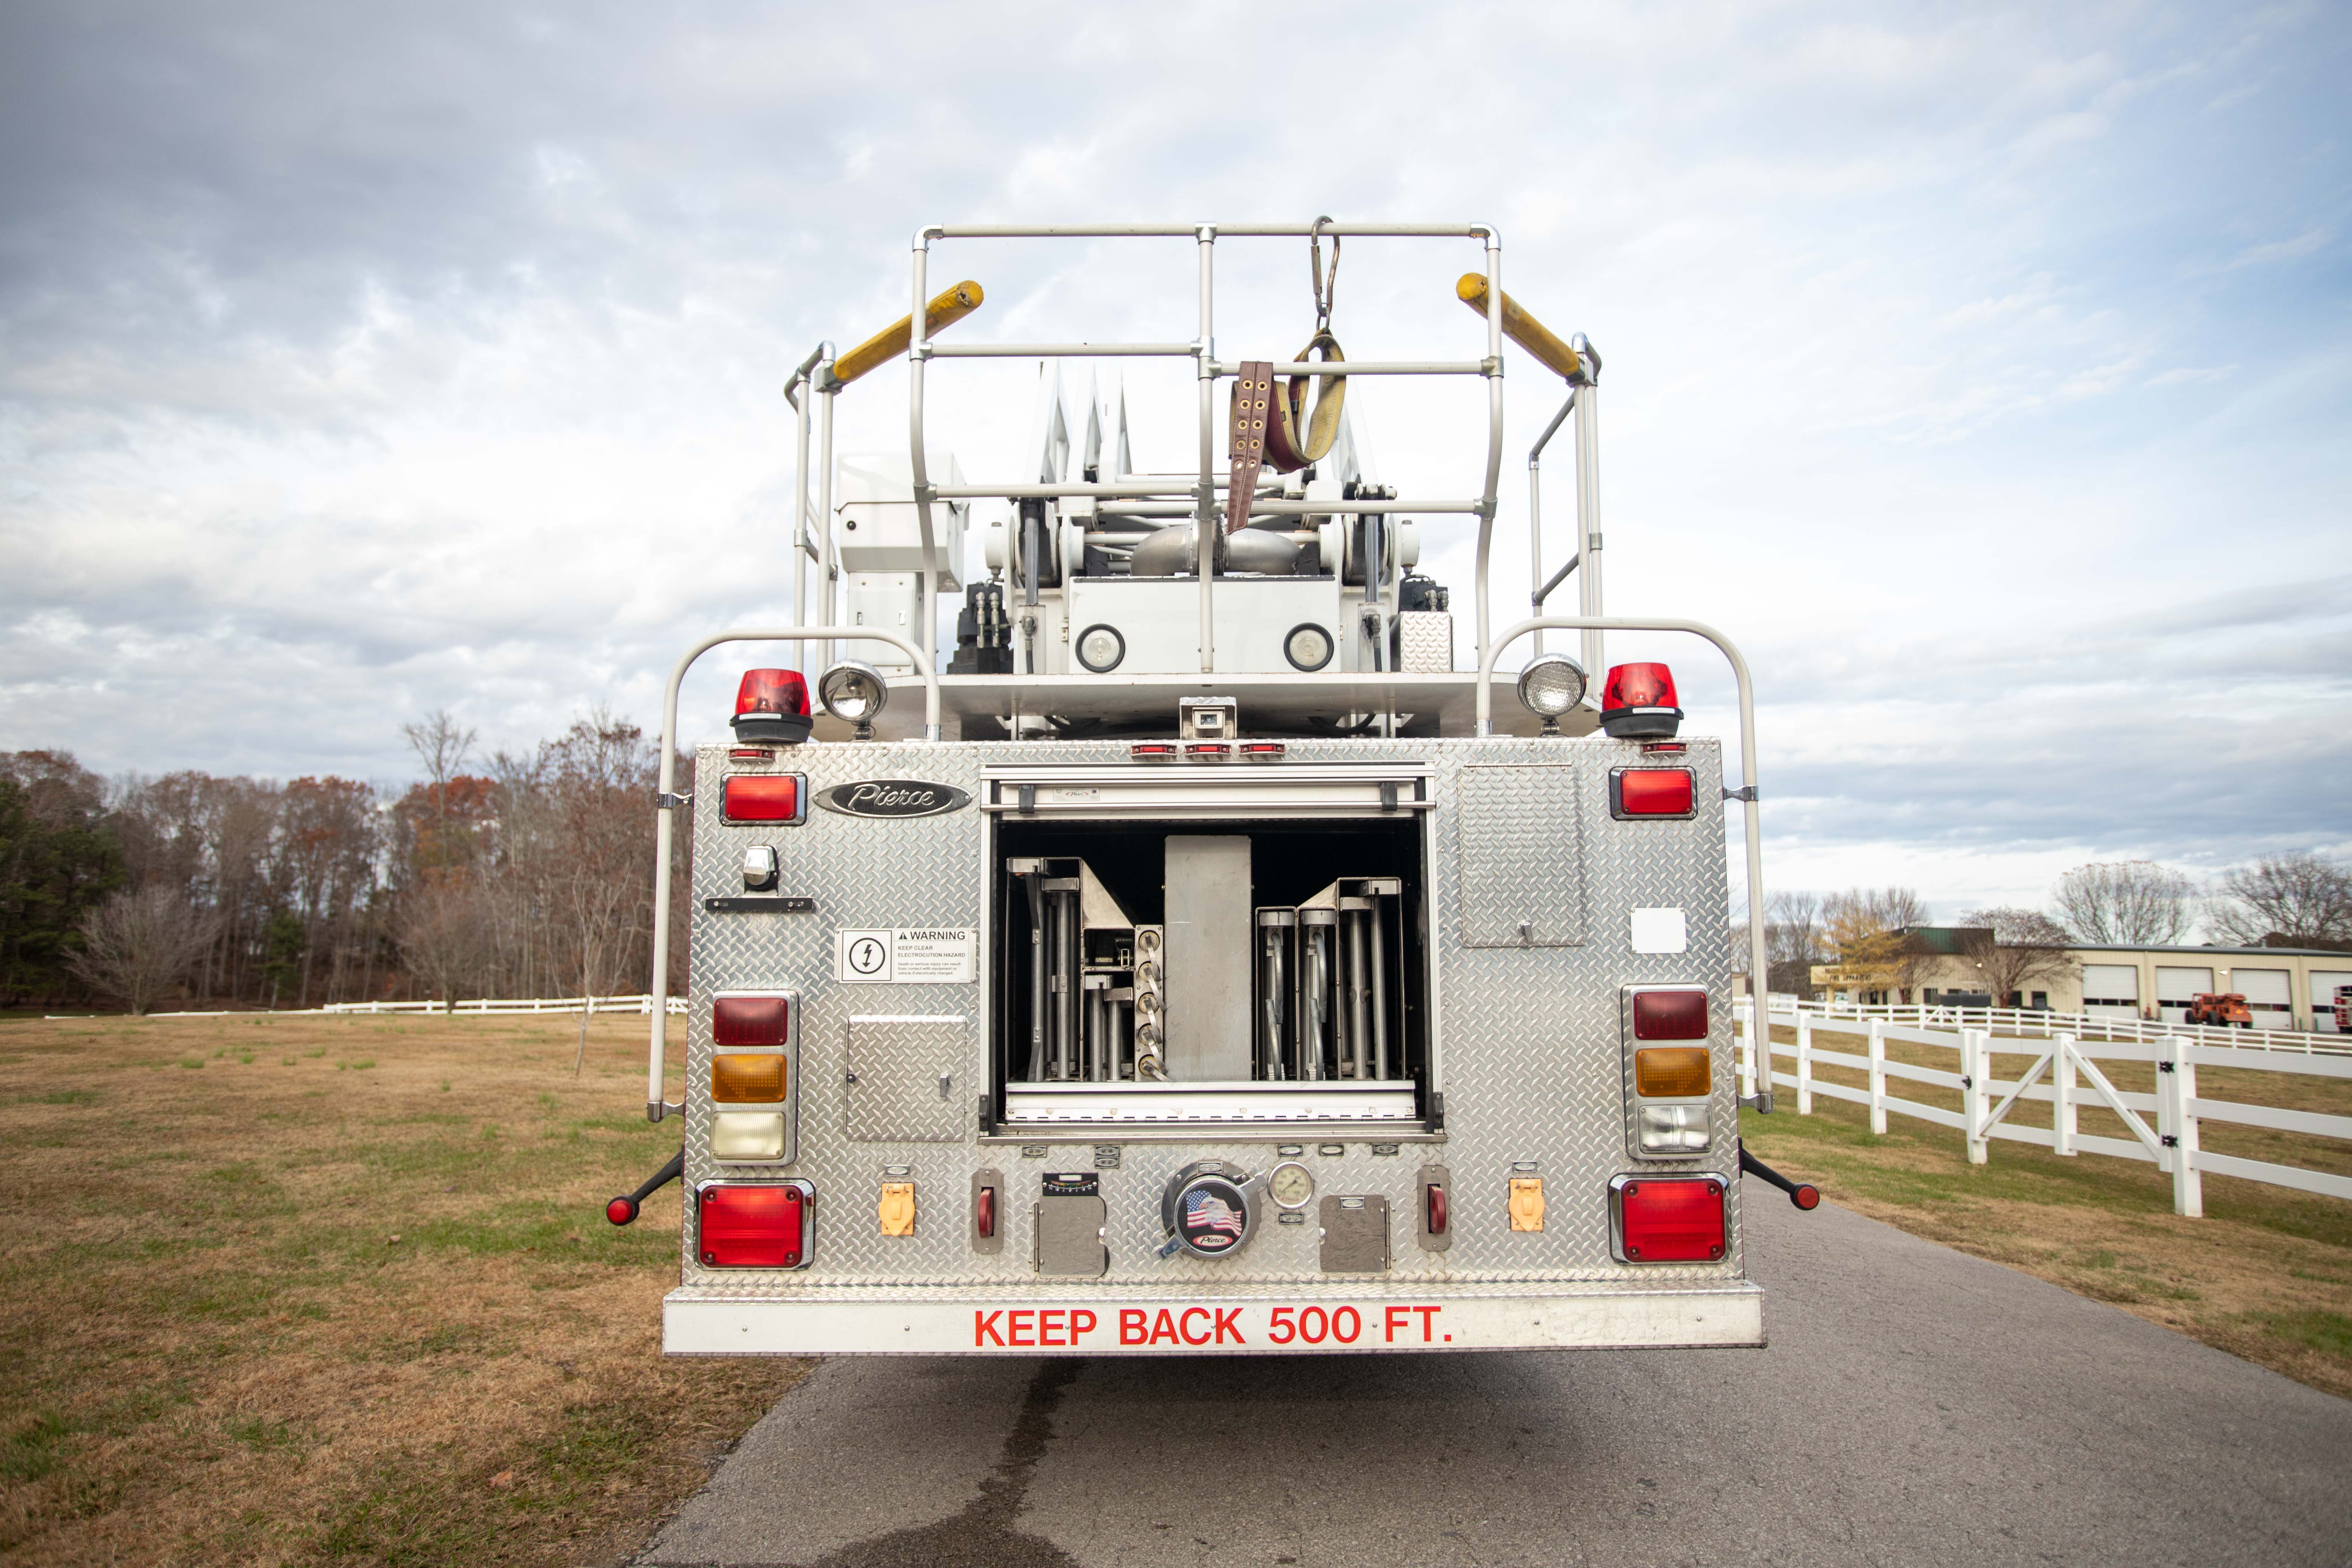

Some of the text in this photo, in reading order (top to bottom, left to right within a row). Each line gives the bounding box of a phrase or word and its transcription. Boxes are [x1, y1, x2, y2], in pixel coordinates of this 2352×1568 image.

[848, 783, 935, 811] Pierce
[910, 931, 965, 940] WARNING
[975, 1306, 1451, 1346] KEEP BACK 500 FT.
